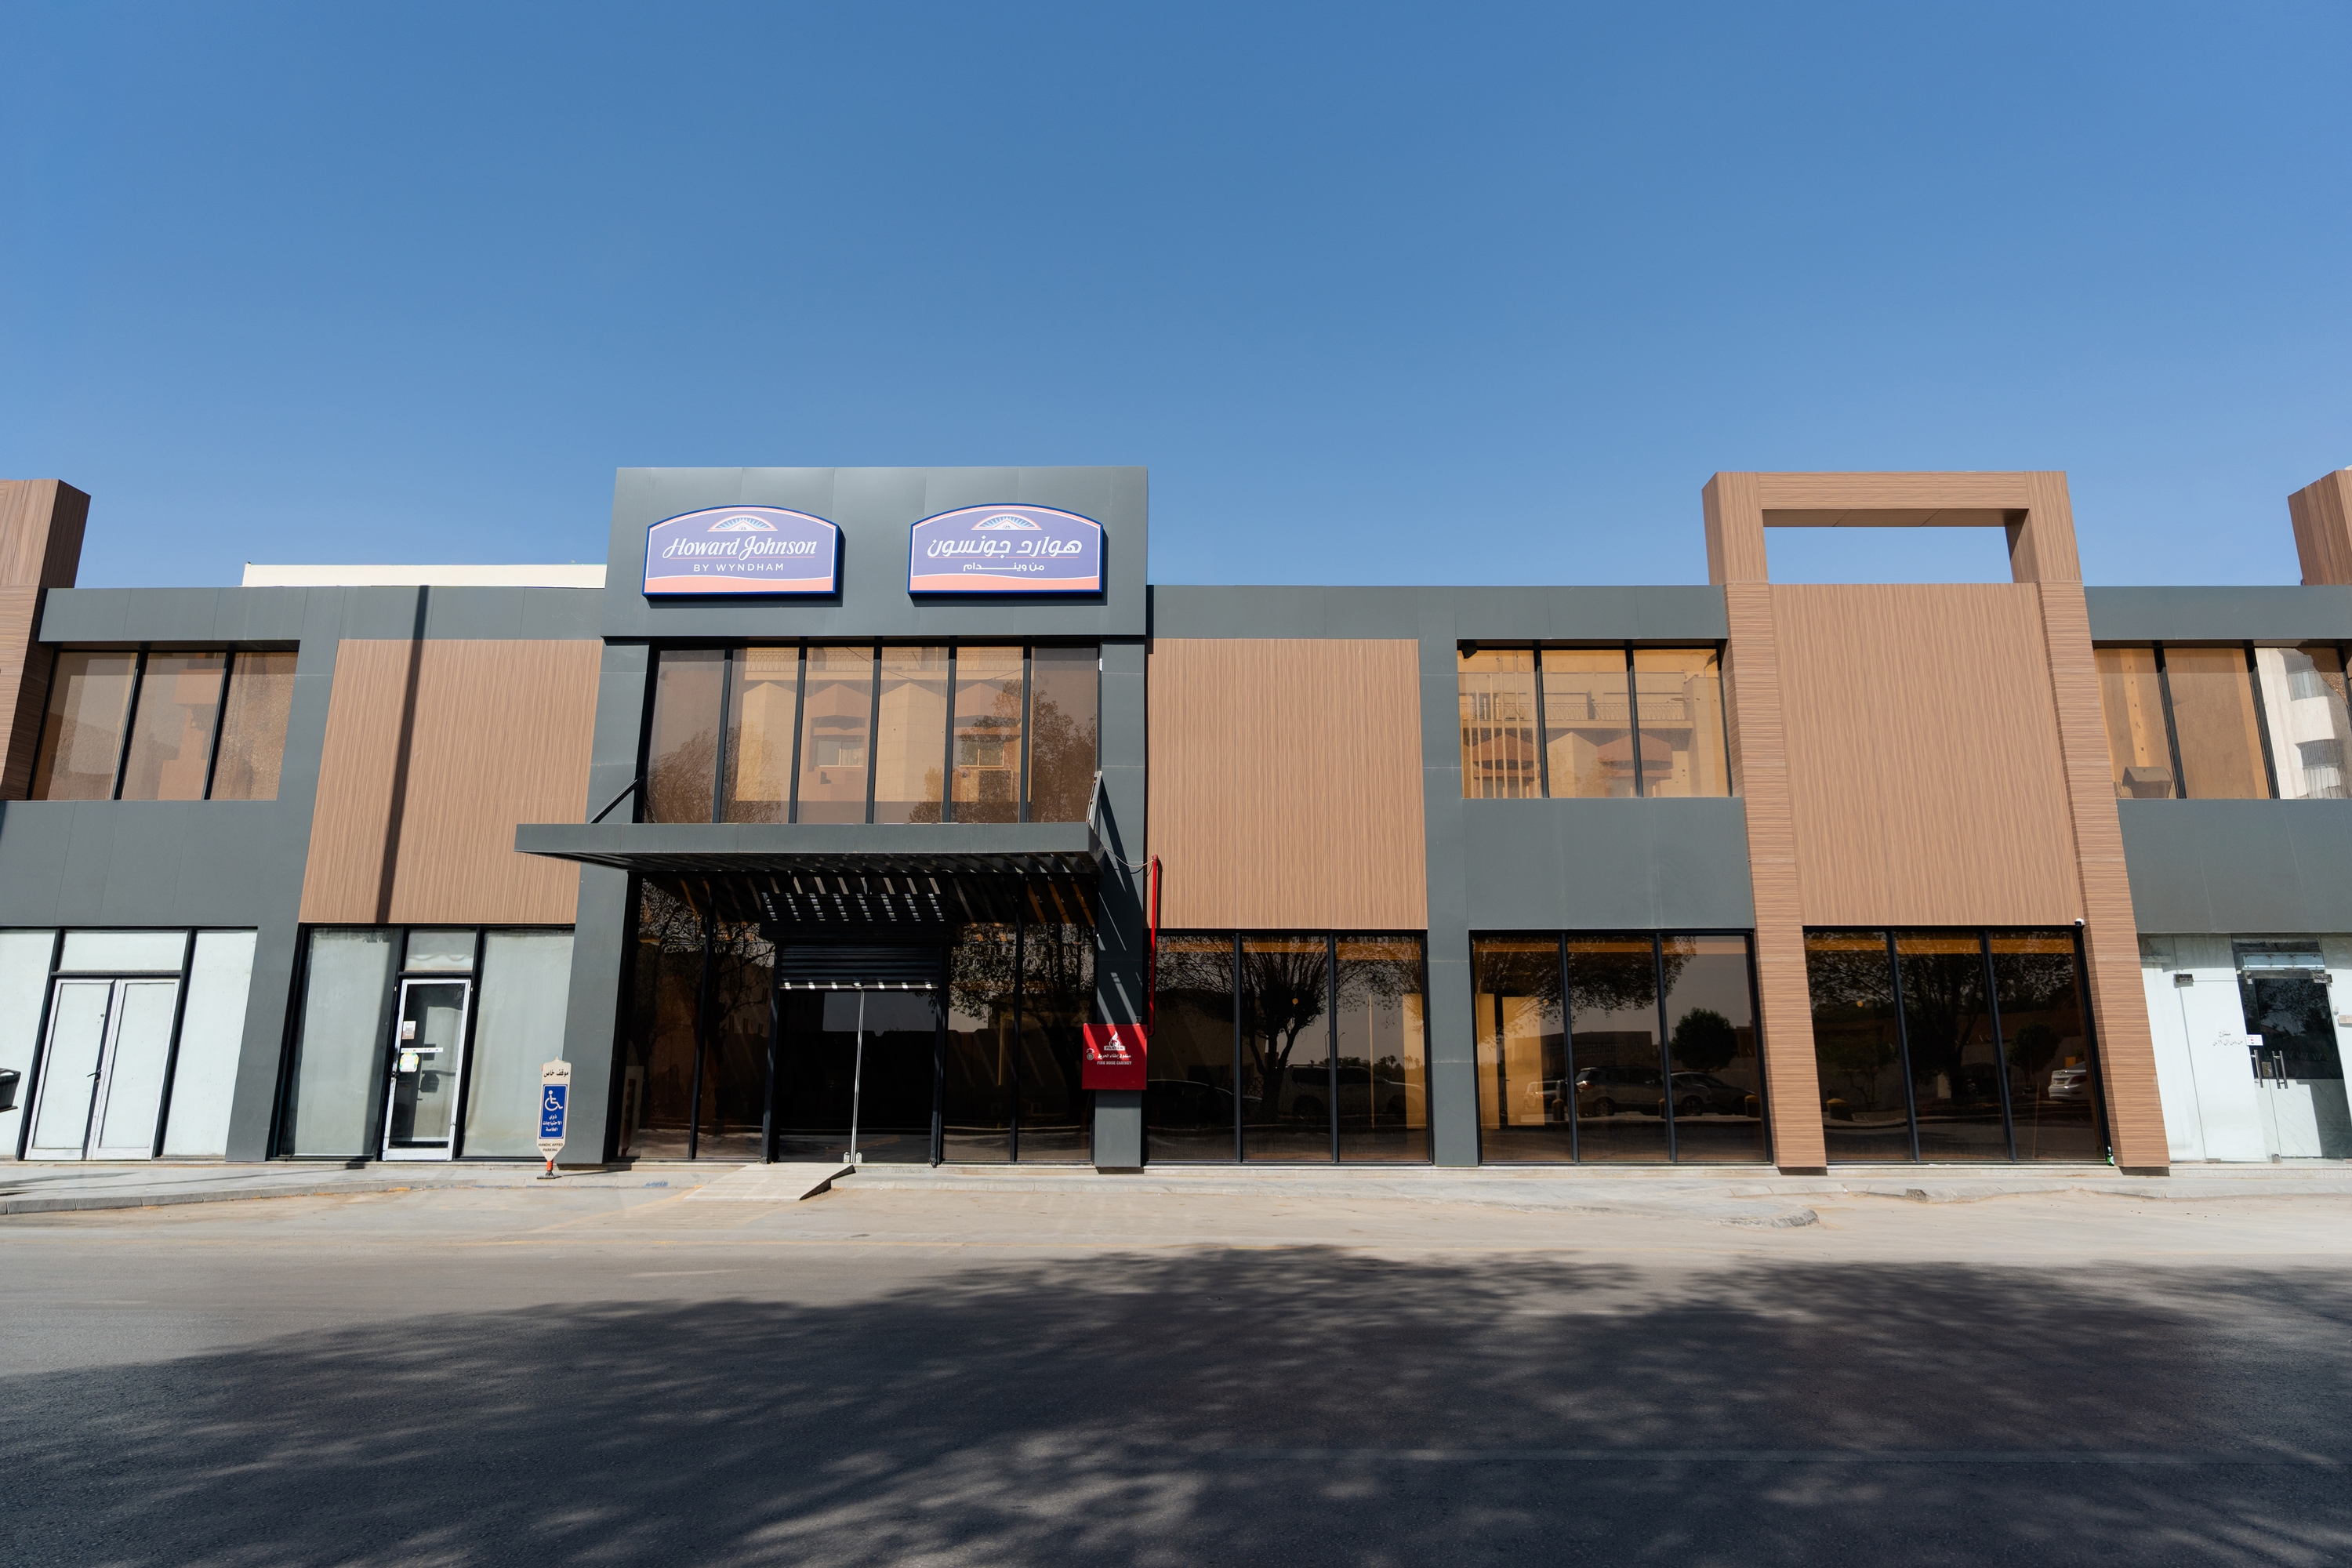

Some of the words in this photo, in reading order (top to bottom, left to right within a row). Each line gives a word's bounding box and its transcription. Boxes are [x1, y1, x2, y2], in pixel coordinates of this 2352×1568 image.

[662, 537, 741, 559] Howard
[739, 535, 818, 561] Johnson
[927, 535, 1011, 559] جونسون
[1015, 535, 1083, 557] هوارد
[693, 564, 710, 572] BY
[716, 563, 785, 572] WYNDHAM
[1029, 562, 1045, 572] من
[543, 1069, 555, 1078] خاص
[556, 1069, 569, 1078] موقف
